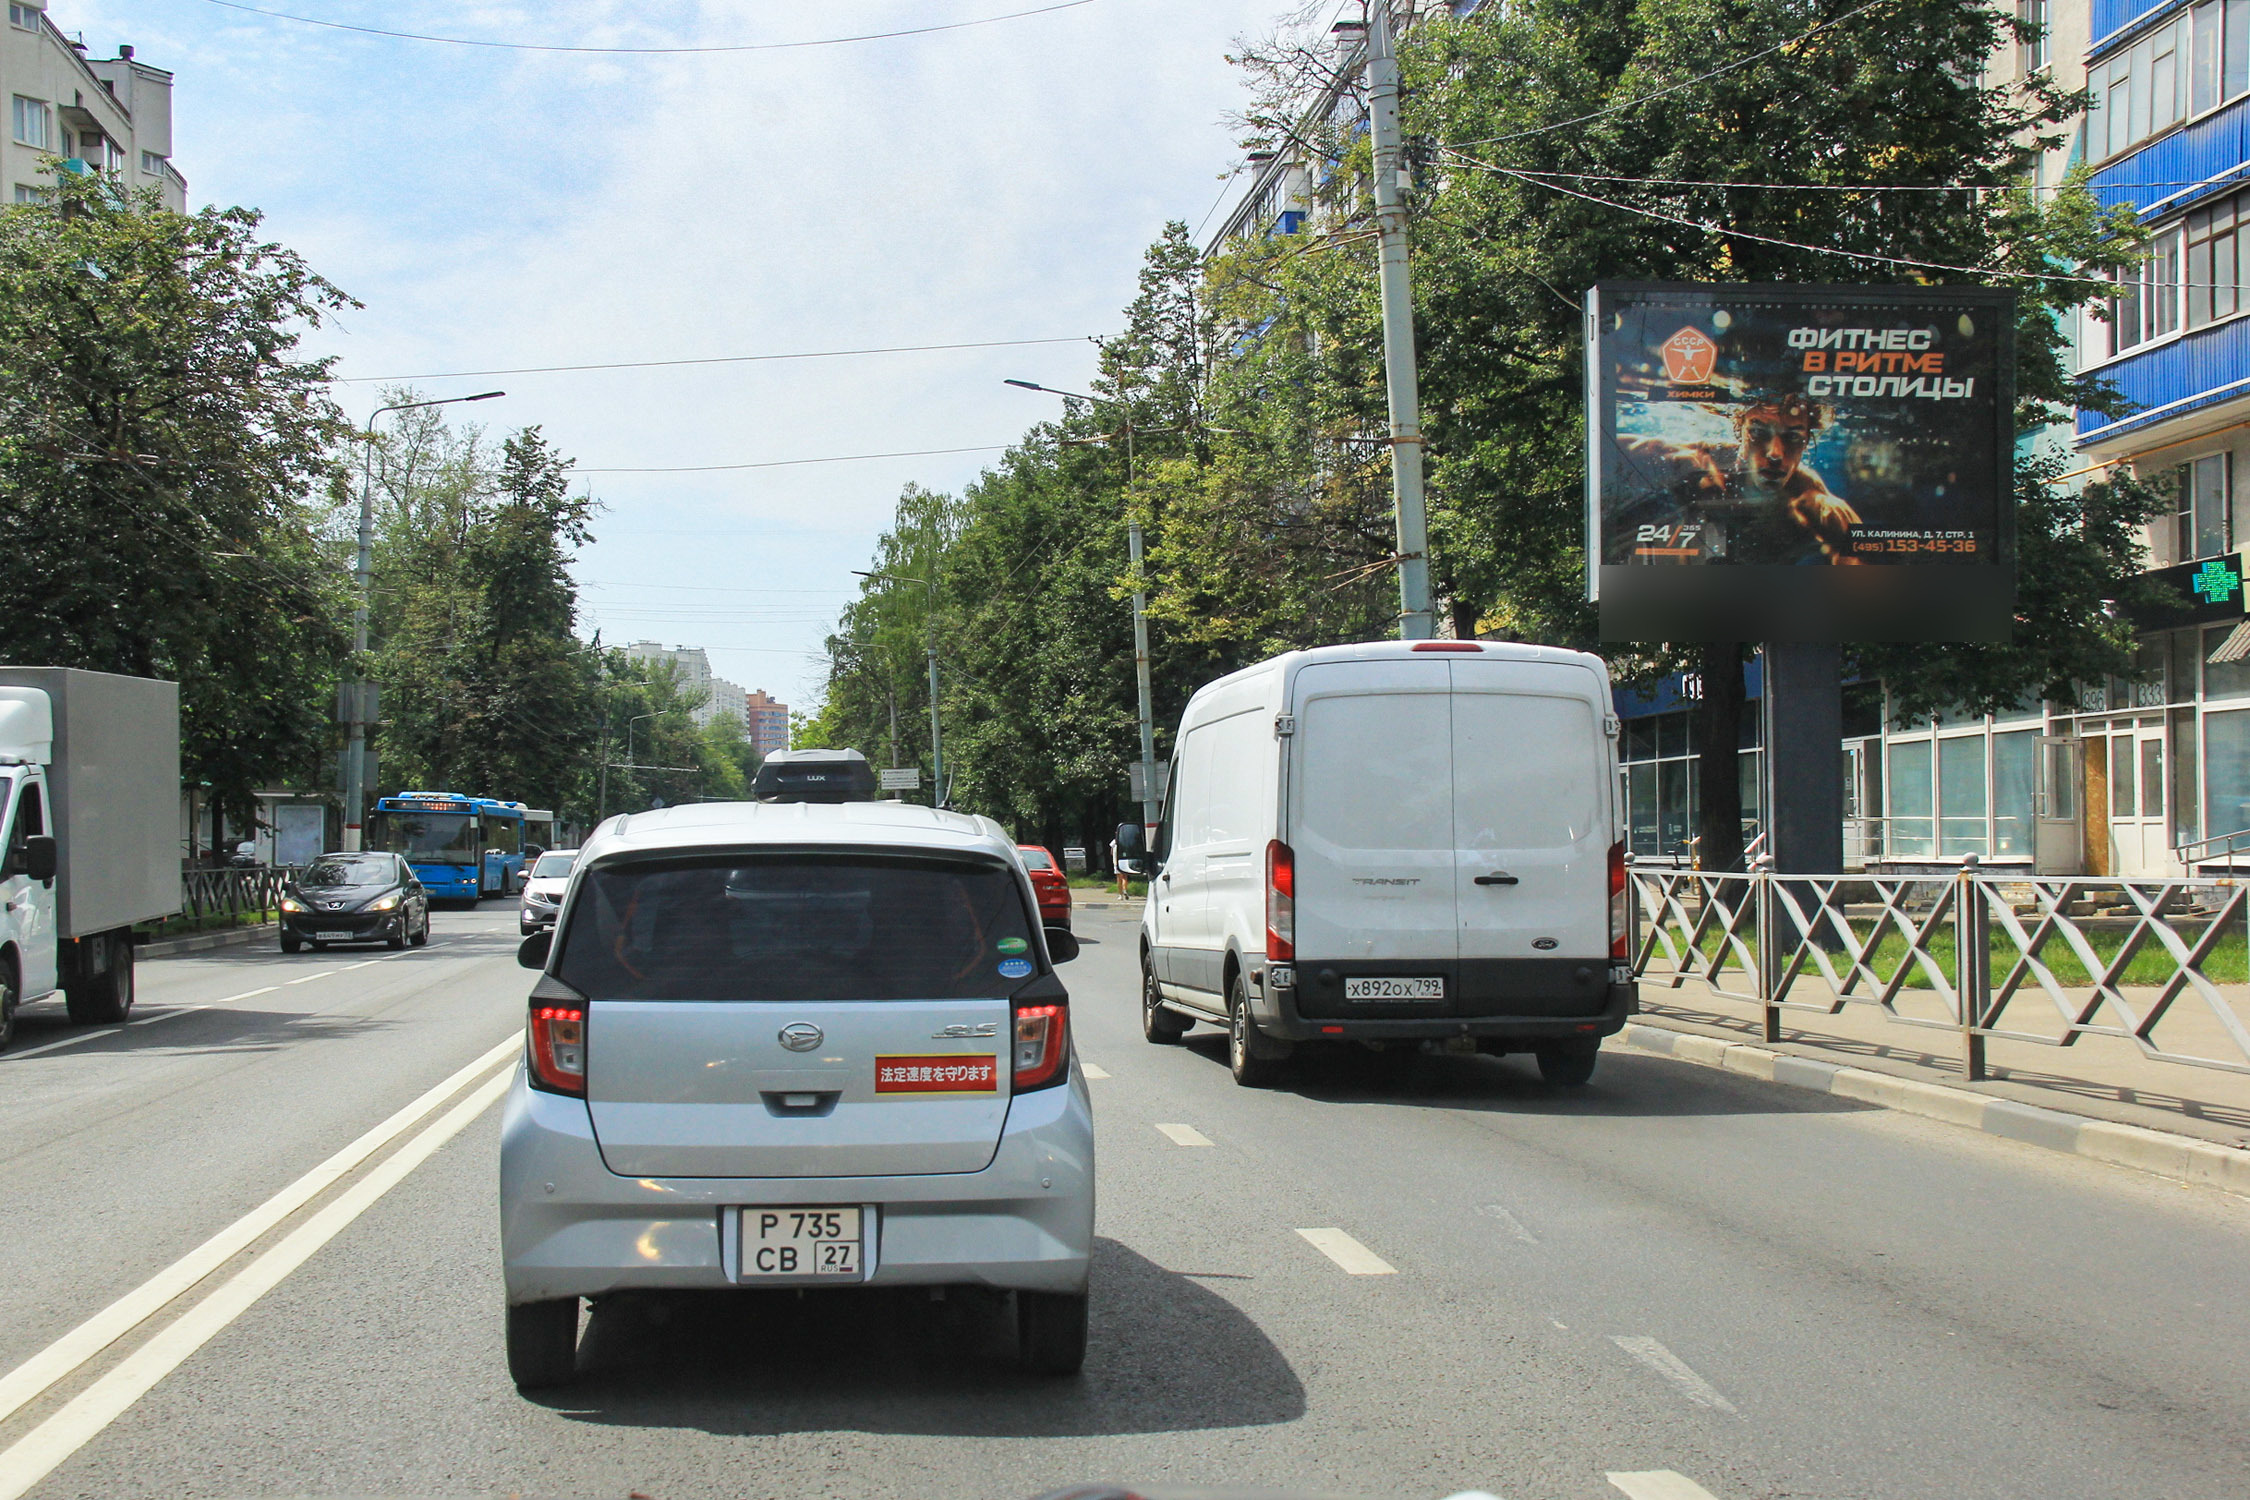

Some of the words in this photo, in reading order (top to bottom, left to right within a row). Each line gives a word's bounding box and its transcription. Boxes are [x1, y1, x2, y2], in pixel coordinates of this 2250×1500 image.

[1673, 336, 1704, 346] СССР
[1787, 327, 1932, 350] ФИТНЕС
[1803, 351, 1827, 372] В
[1834, 352, 1945, 373] РИТМЕ
[1667, 390, 1716, 399] ХИМКИ
[1808, 375, 1974, 400] СТОЛИЦЫ
[1636, 524, 1697, 548] 24/7
[1851, 530, 1865, 538] УЛ.
[1867, 530, 1921, 539] КАЛИНИНА,
[1923, 531, 1934, 539] Д.
[1935, 531, 1944, 539] 7,
[1945, 531, 1967, 539] СТР.
[1968, 531, 1975, 539] 1
[1852, 541, 1884, 552] (495)
[1887, 540, 1977, 553] 153-45-36
[1352, 878, 1421, 886] TRANSIT
[1415, 979, 1439, 992] 799
[880, 1065, 992, 1082] 法定速度を守ります
[789, 1212, 841, 1239] 735
[824, 1245, 850, 1265] 27
[820, 1264, 839, 1273] RUS
